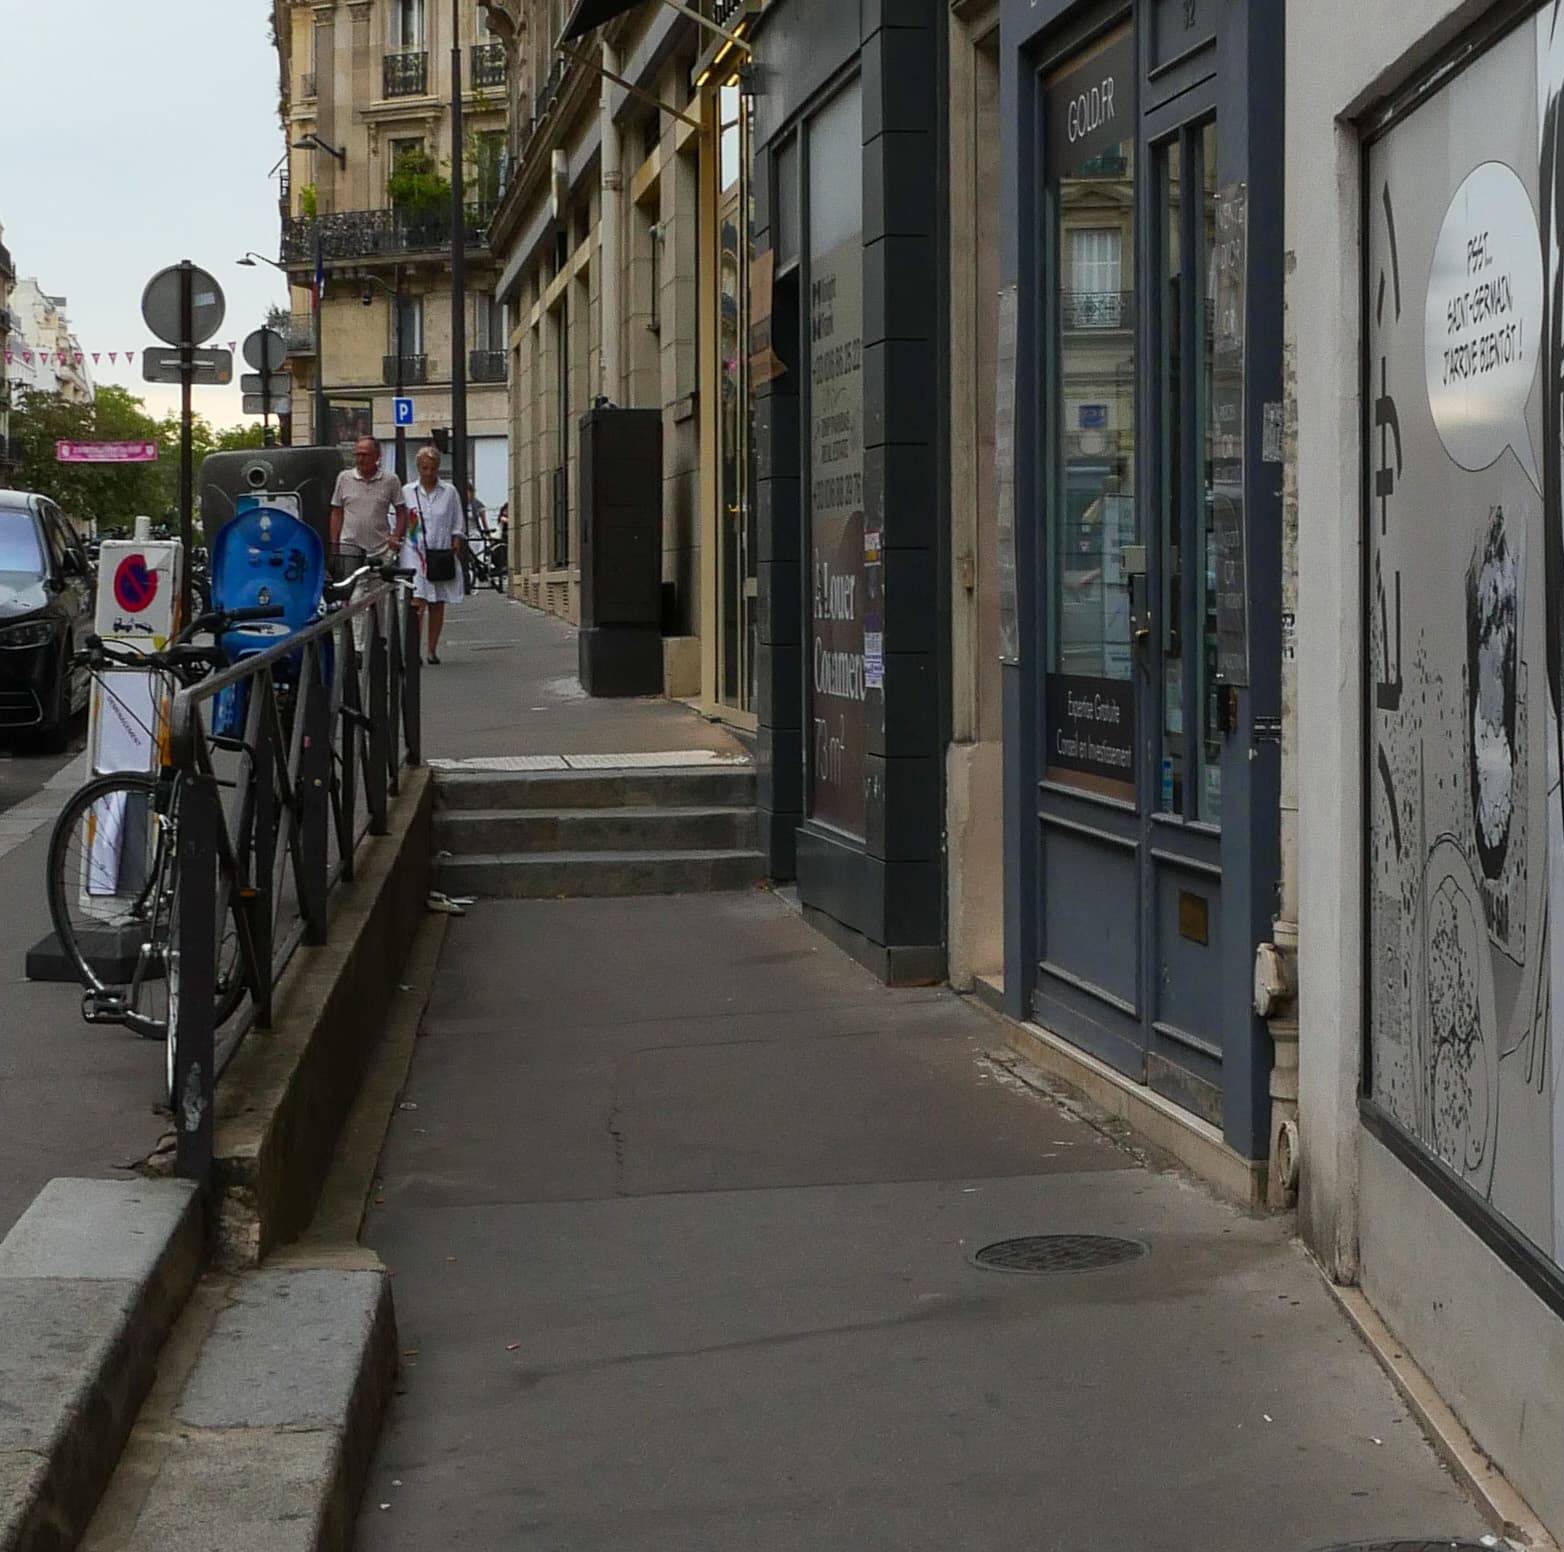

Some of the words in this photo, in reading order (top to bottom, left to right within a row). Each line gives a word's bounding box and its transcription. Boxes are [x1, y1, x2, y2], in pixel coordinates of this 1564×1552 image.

[1068, 77, 1115, 143] GOLD.FR
[1480, 323, 1516, 373] BIENTÔT
[814, 636, 865, 701] Commerc
